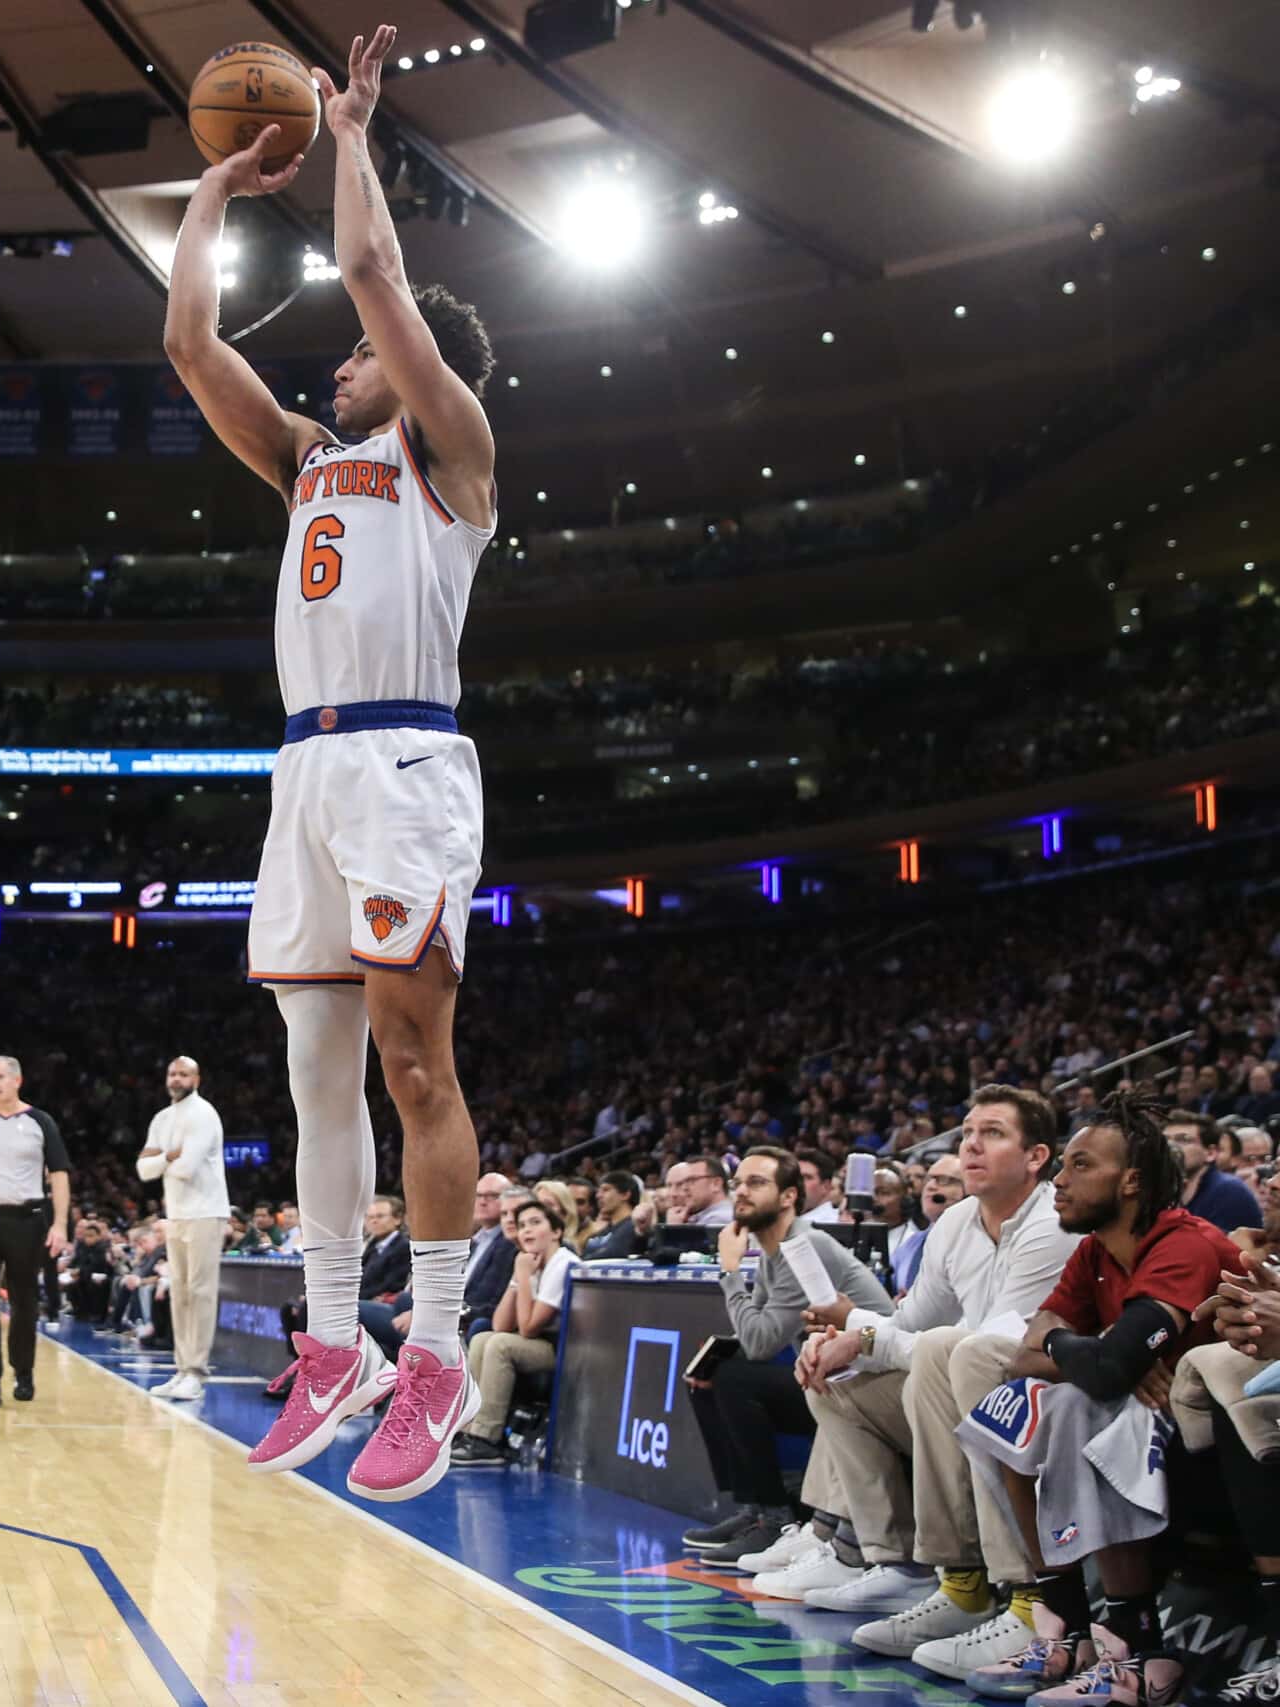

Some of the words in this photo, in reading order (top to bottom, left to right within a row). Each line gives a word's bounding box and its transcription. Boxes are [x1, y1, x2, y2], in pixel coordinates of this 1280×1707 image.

[322, 459, 401, 505] YORK
[300, 513, 345, 602] 6
[364, 896, 409, 922] KNICKS
[978, 1383, 1026, 1429] NBA
